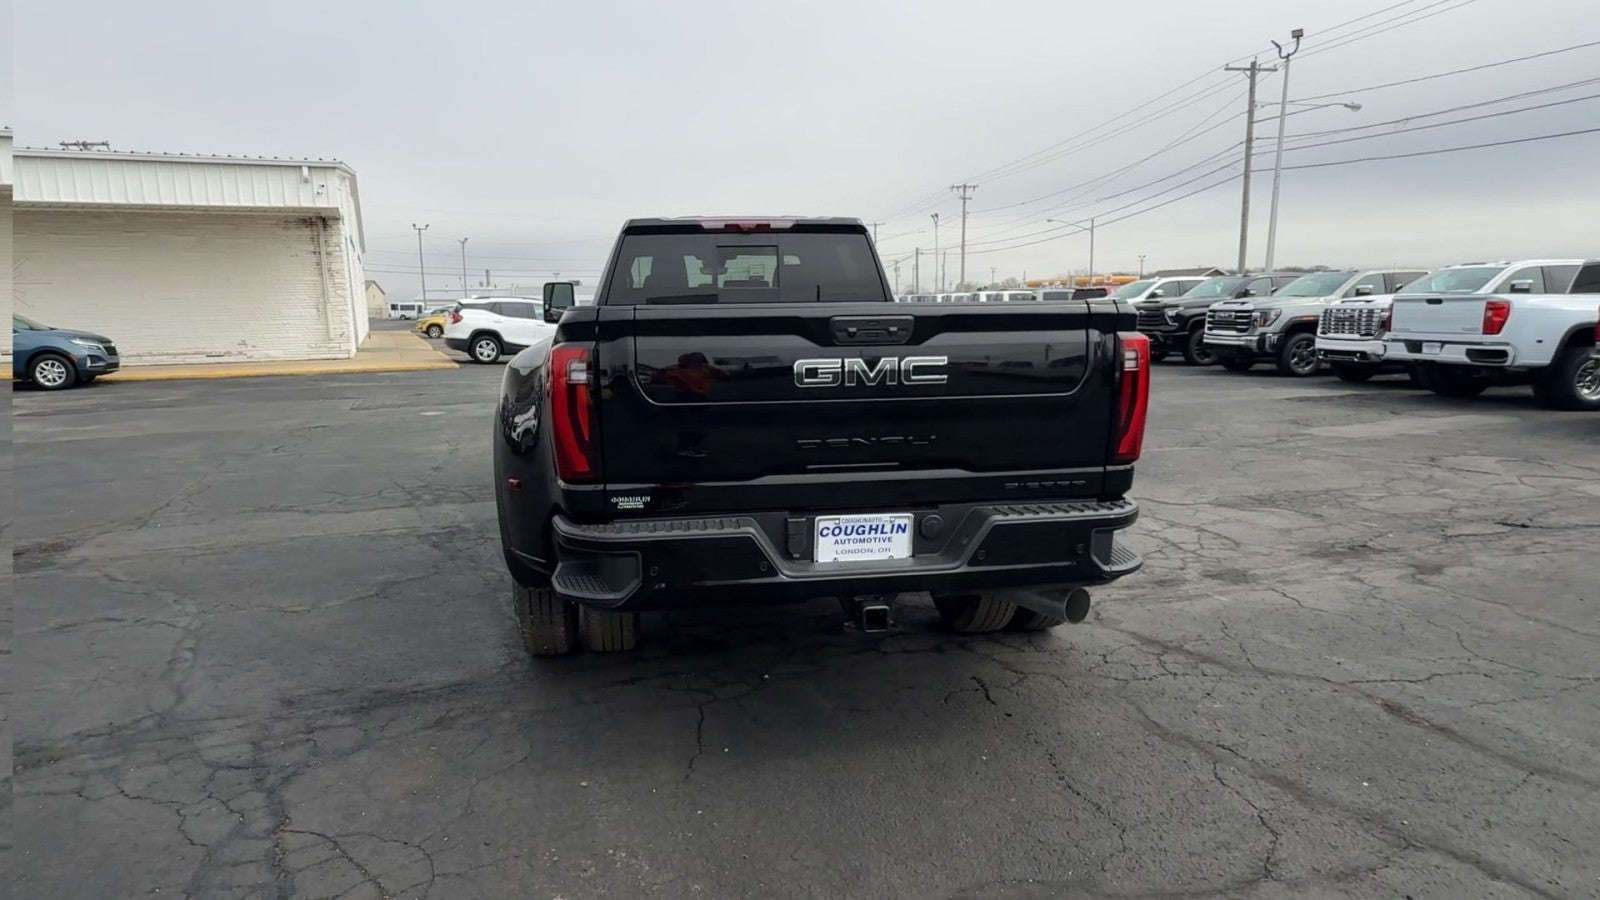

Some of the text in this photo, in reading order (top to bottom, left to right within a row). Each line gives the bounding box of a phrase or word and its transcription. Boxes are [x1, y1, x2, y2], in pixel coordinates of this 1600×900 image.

[793, 356, 948, 387] GMC
[820, 523, 907, 537] COUGHLIN
[833, 536, 893, 545] AUTOMOTIVE
